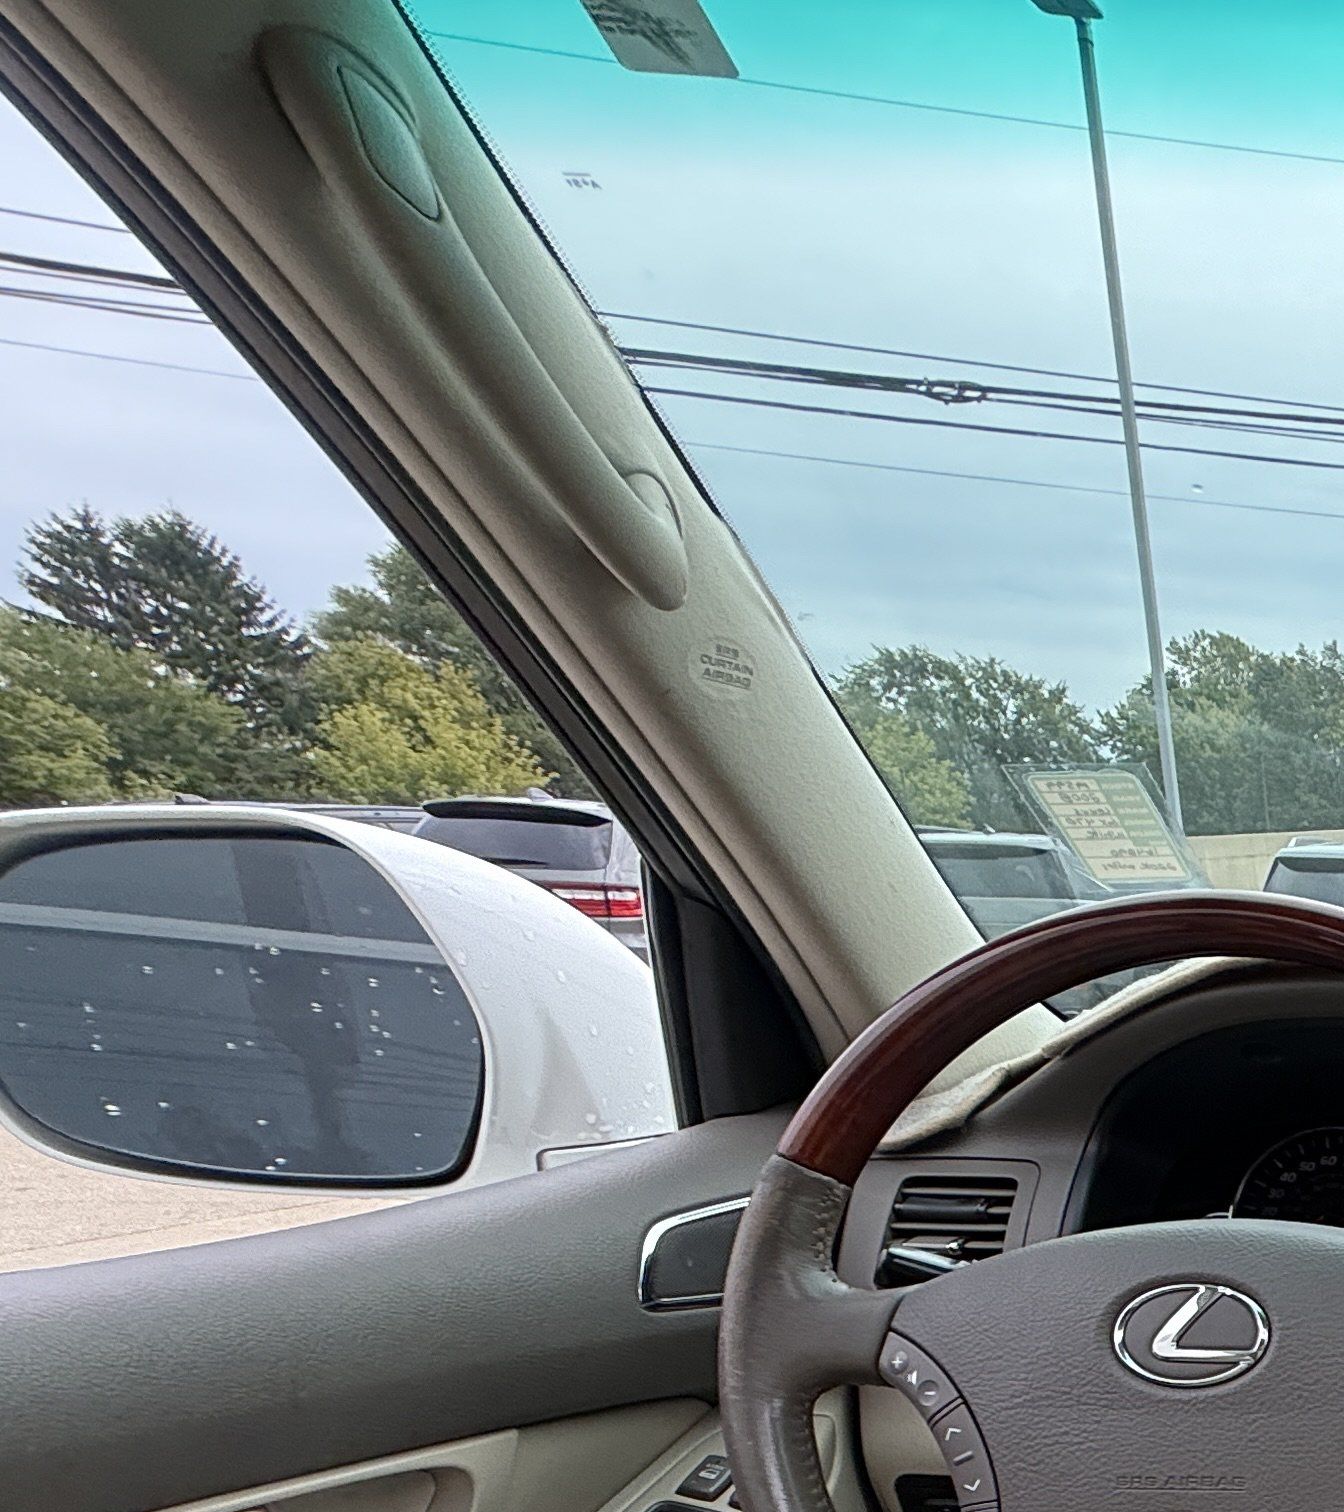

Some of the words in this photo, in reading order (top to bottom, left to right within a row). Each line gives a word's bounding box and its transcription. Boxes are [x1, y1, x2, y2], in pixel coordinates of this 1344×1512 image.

[1320, 1155, 1338, 1166] 60
[1299, 1161, 1316, 1172] 50
[1280, 1171, 1297, 1183] 40
